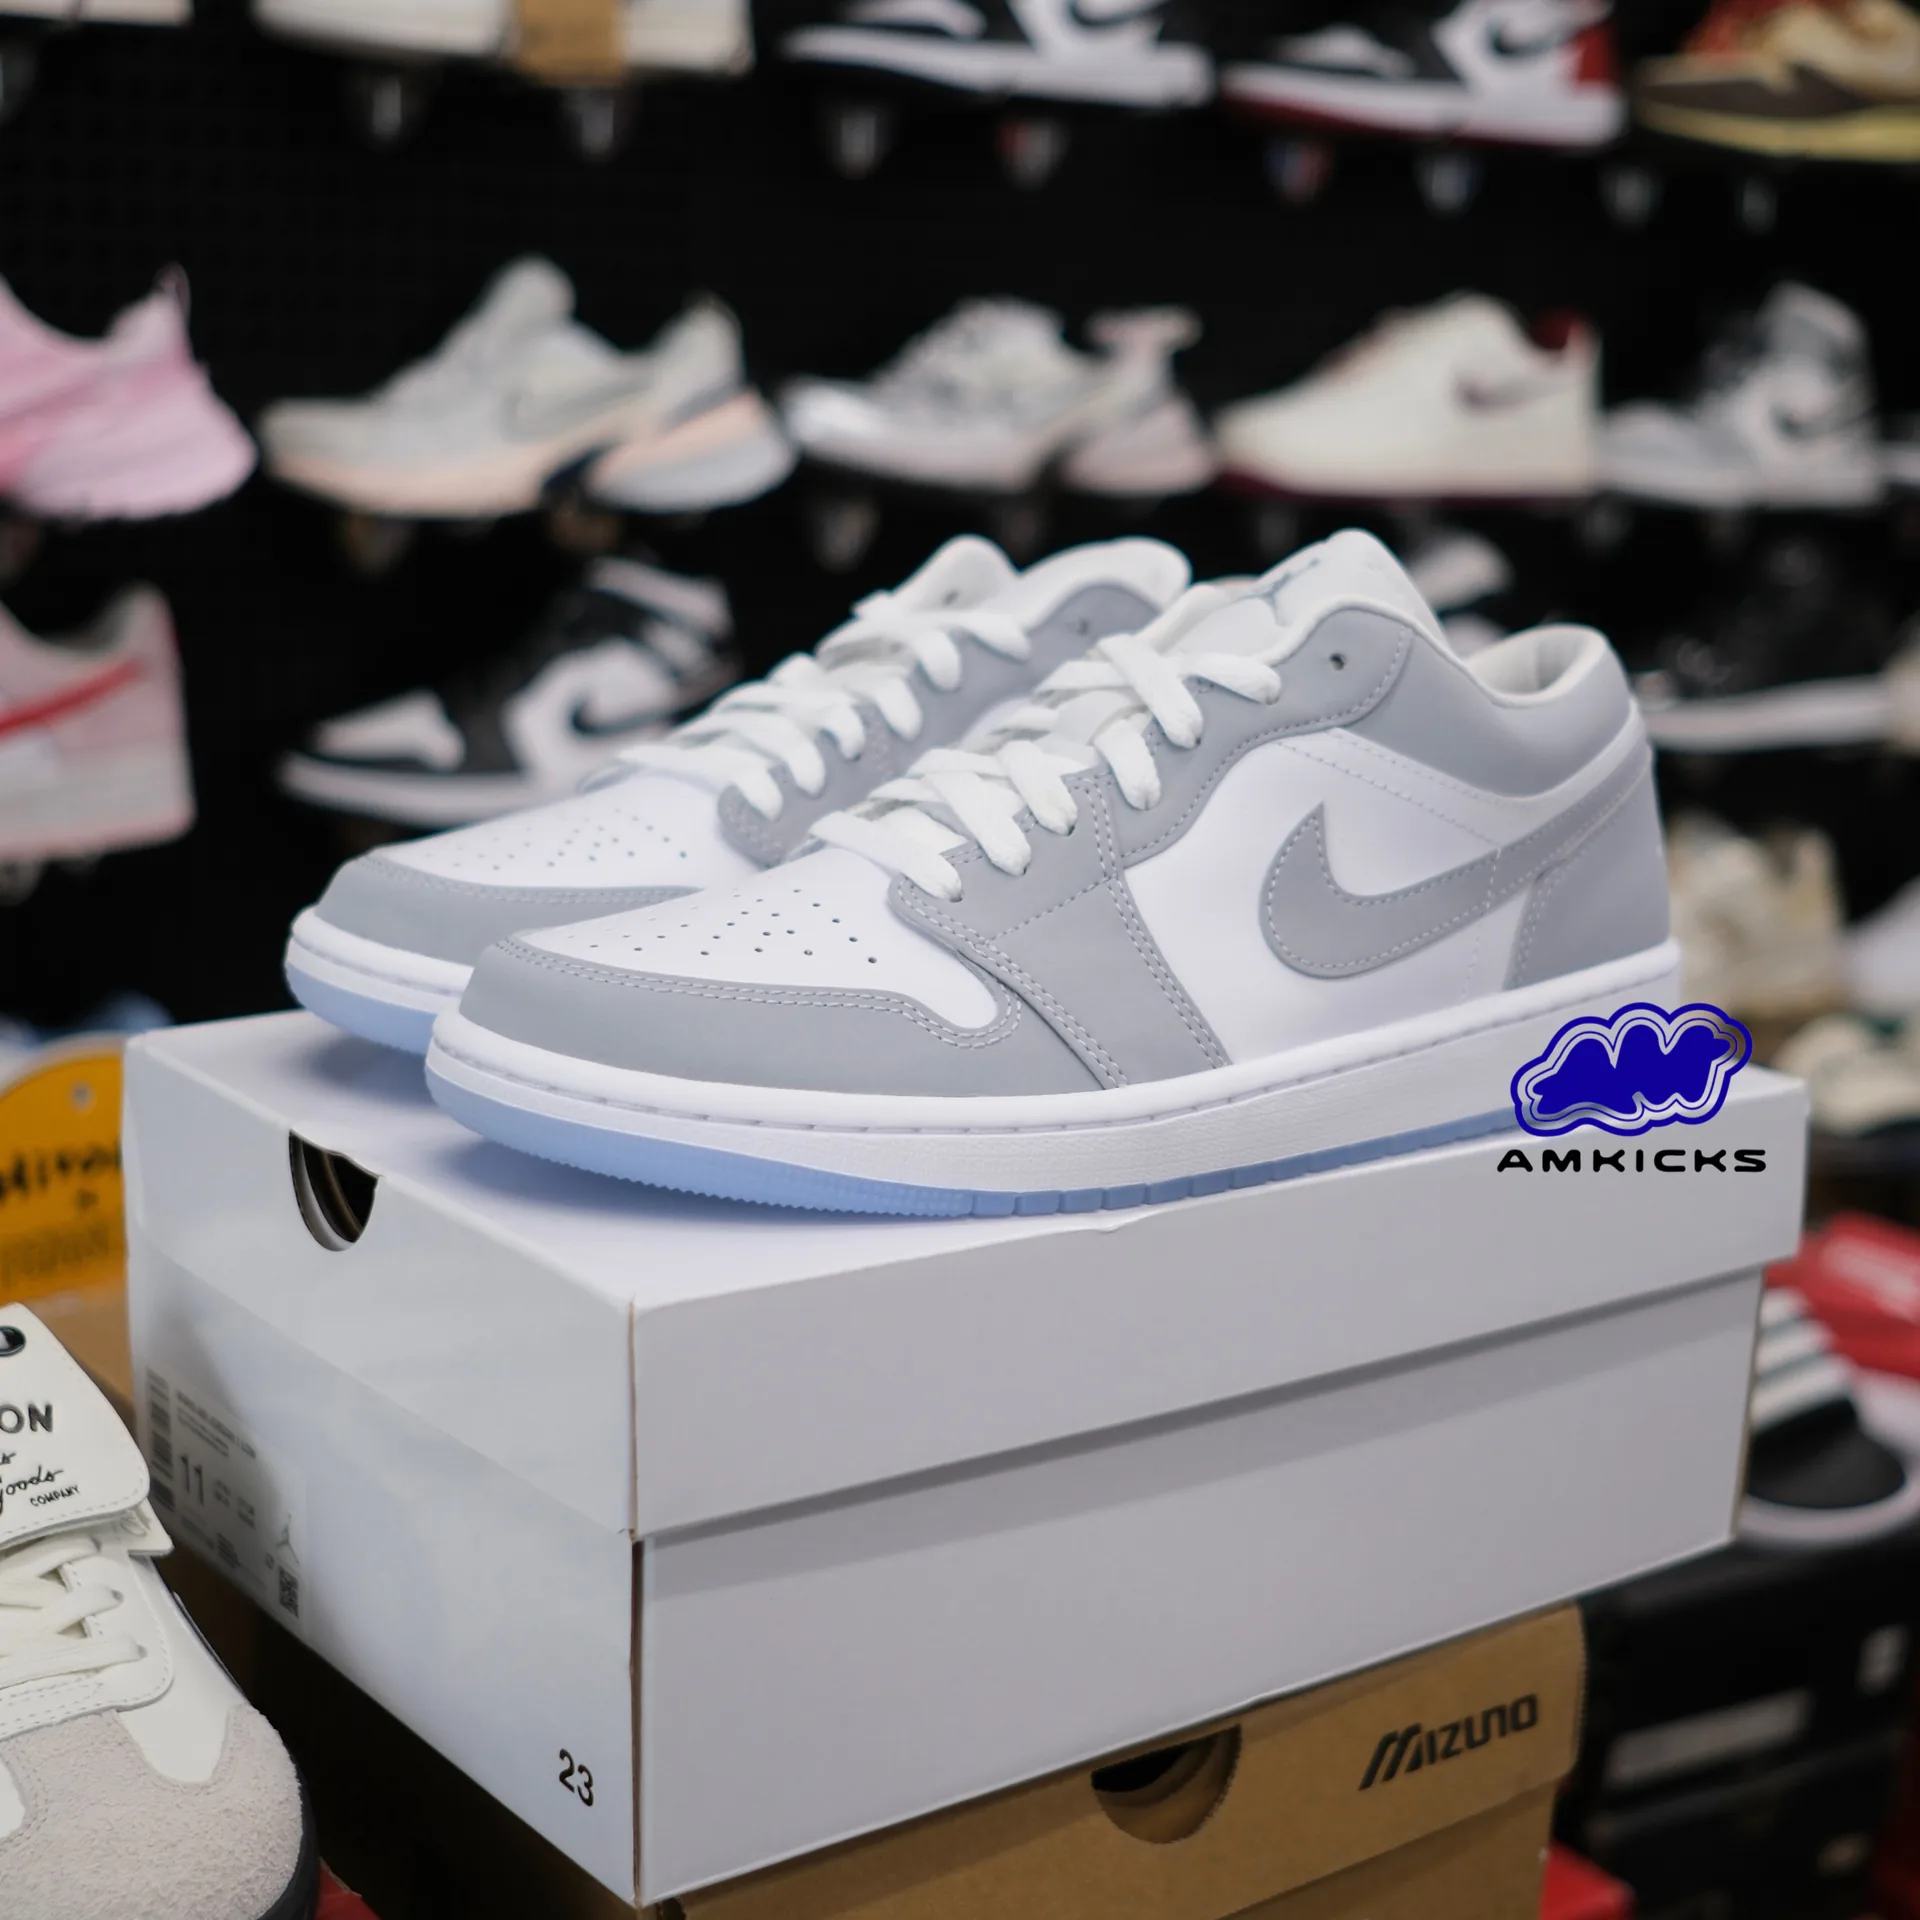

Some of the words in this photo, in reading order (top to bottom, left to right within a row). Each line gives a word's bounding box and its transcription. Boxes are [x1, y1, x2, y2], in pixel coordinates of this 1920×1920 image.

[29, 1484, 80, 1507] COMPANY
[180, 1454, 205, 1507] 11
[558, 1748, 594, 1807] 23
